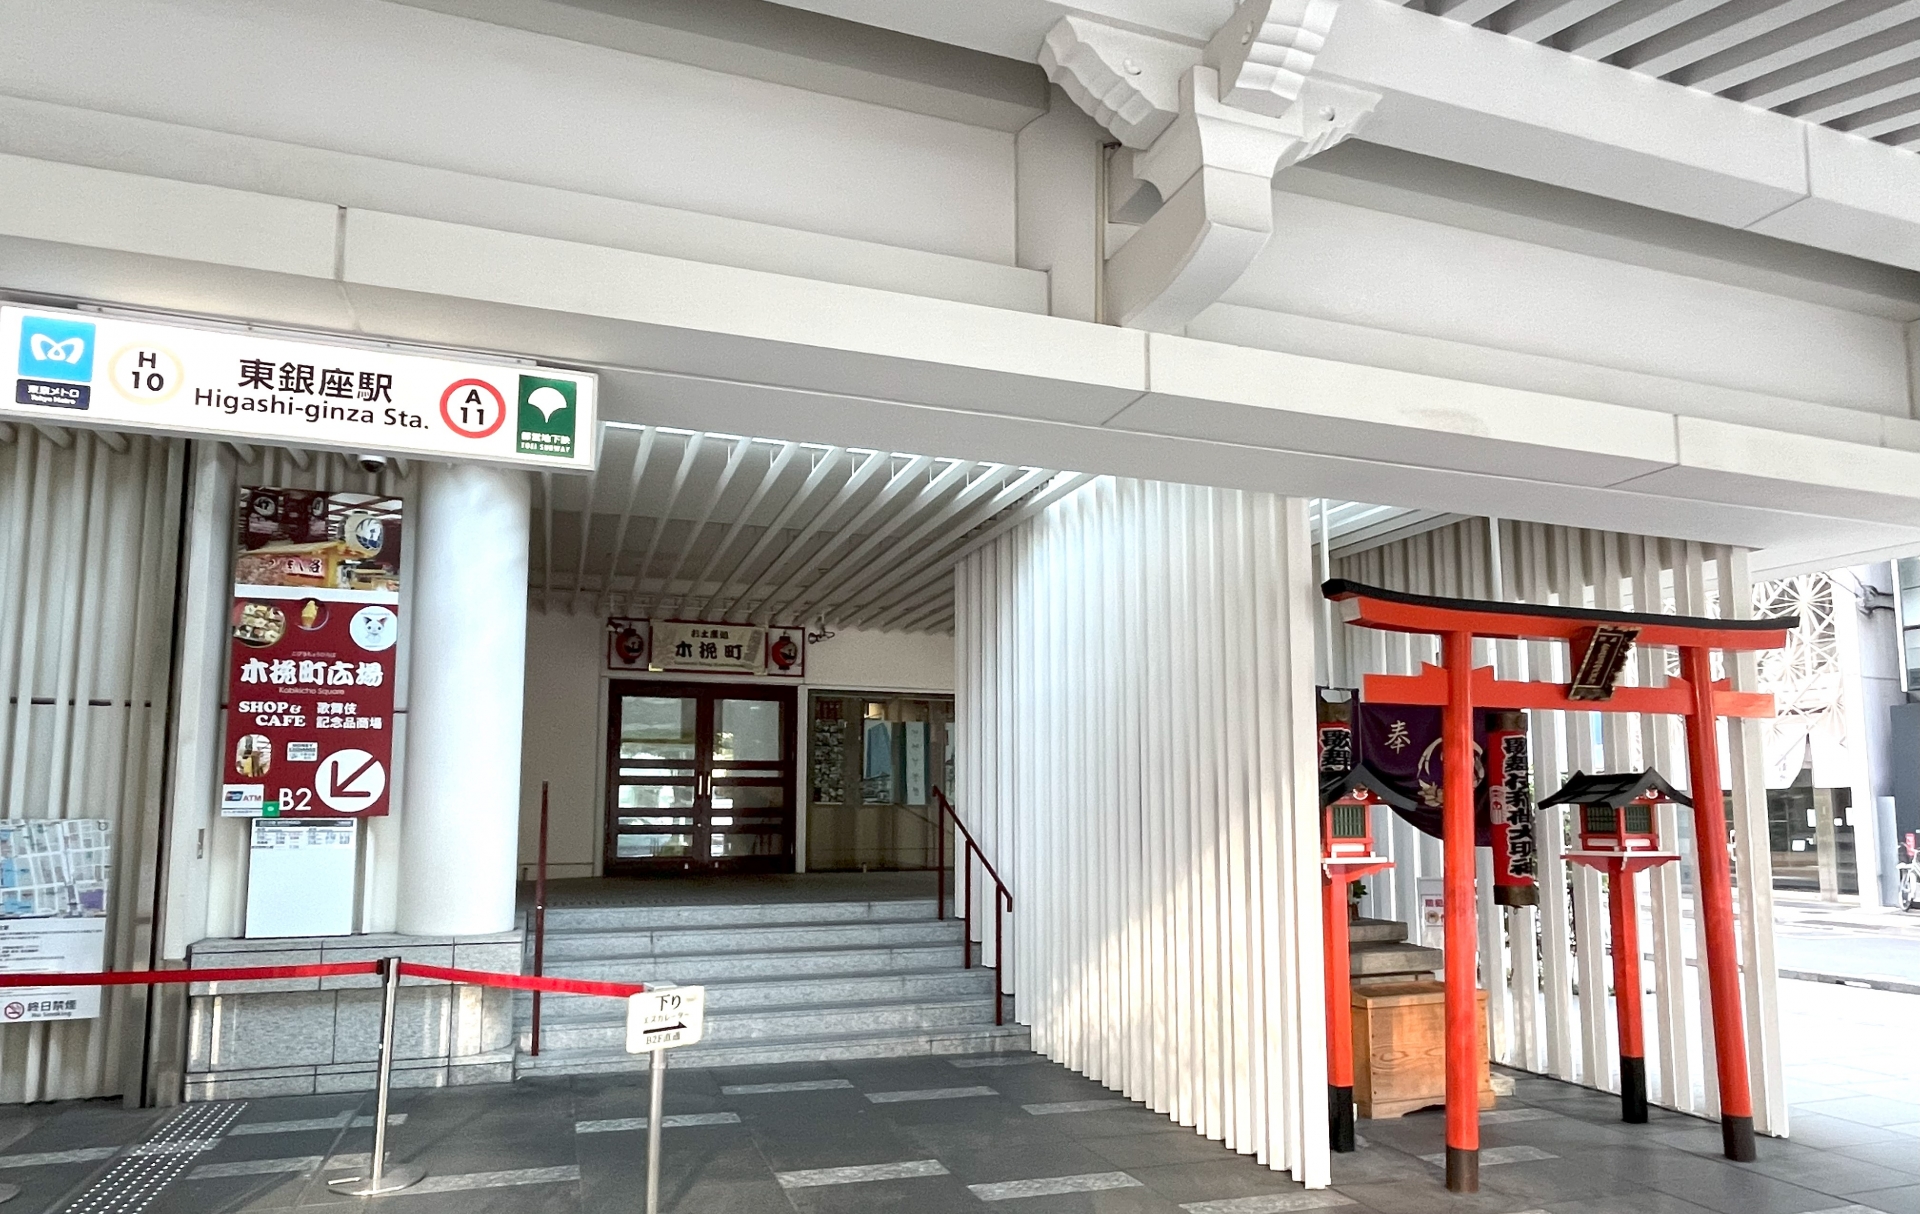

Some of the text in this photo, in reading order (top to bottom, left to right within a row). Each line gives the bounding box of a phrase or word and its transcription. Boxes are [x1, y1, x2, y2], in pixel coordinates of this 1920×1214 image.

[138, 351, 156, 369] H
[132, 371, 164, 392] 10
[238, 358, 393, 403] 東銀座駅
[465, 389, 482, 405] A
[195, 387, 430, 430] Higashi-ginza Sta.
[460, 406, 485, 425] 11
[240, 658, 384, 687] 木挽町広場
[238, 701, 302, 714] SHOP &
[316, 702, 358, 715] 歌舞伎
[255, 715, 306, 727] CAFE
[1384, 719, 1411, 754] 奉
[243, 794, 262, 802] ATM
[279, 787, 312, 811] B2
[655, 994, 681, 1011] 下り
